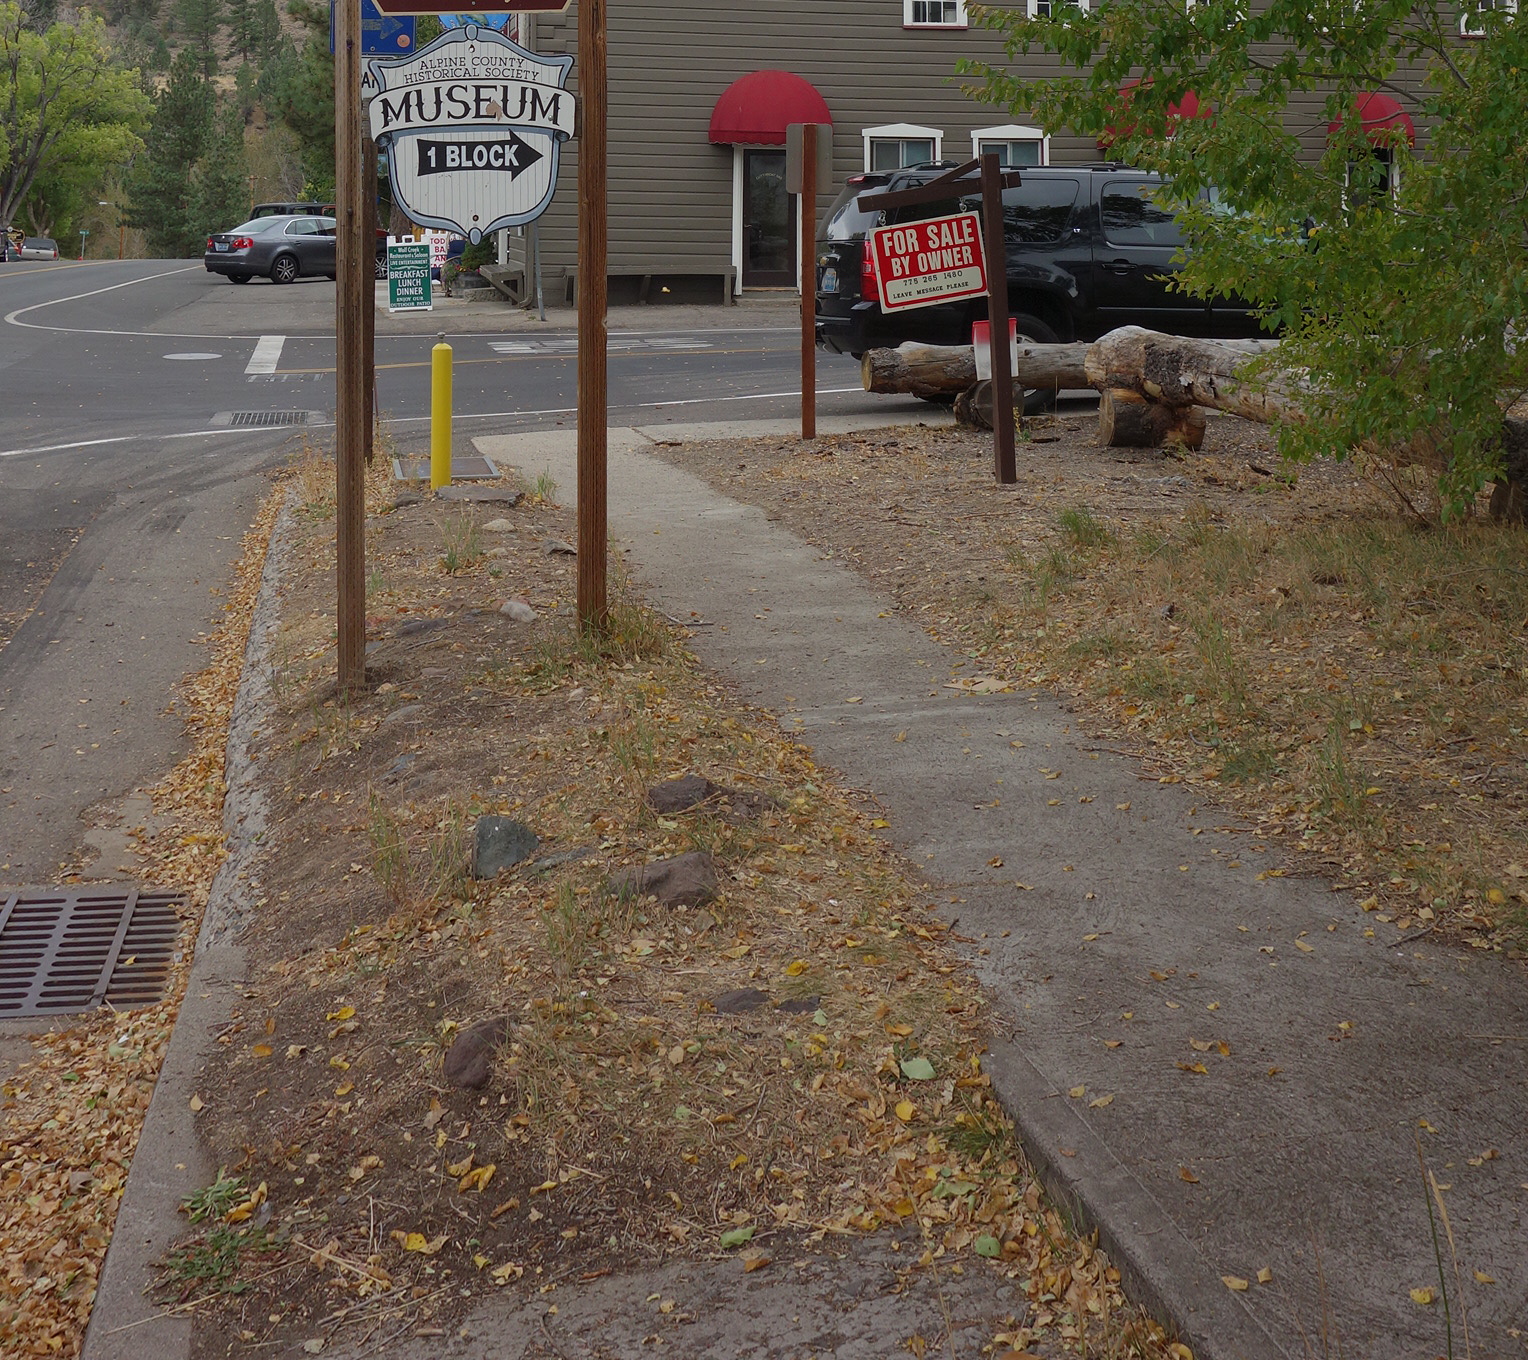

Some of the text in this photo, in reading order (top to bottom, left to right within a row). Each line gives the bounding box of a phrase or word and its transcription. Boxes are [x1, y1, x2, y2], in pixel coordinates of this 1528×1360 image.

[419, 56, 525, 71] ALPINE COUNTY
[404, 67, 540, 84] HISTORICAL SOCIETY
[378, 84, 562, 130] MUSEUM
[427, 144, 520, 168] 1 BLOCK
[882, 218, 975, 257] FOR SALE
[891, 245, 974, 278] BY OWNER
[390, 270, 429, 279] BREAKFAST
[398, 279, 421, 287] LUNCH
[903, 277, 919, 286] 775
[922, 274, 938, 283] 265
[397, 287, 423, 296] DINNER
[893, 281, 969, 300] LEAVE MESSAGE PLEASE
